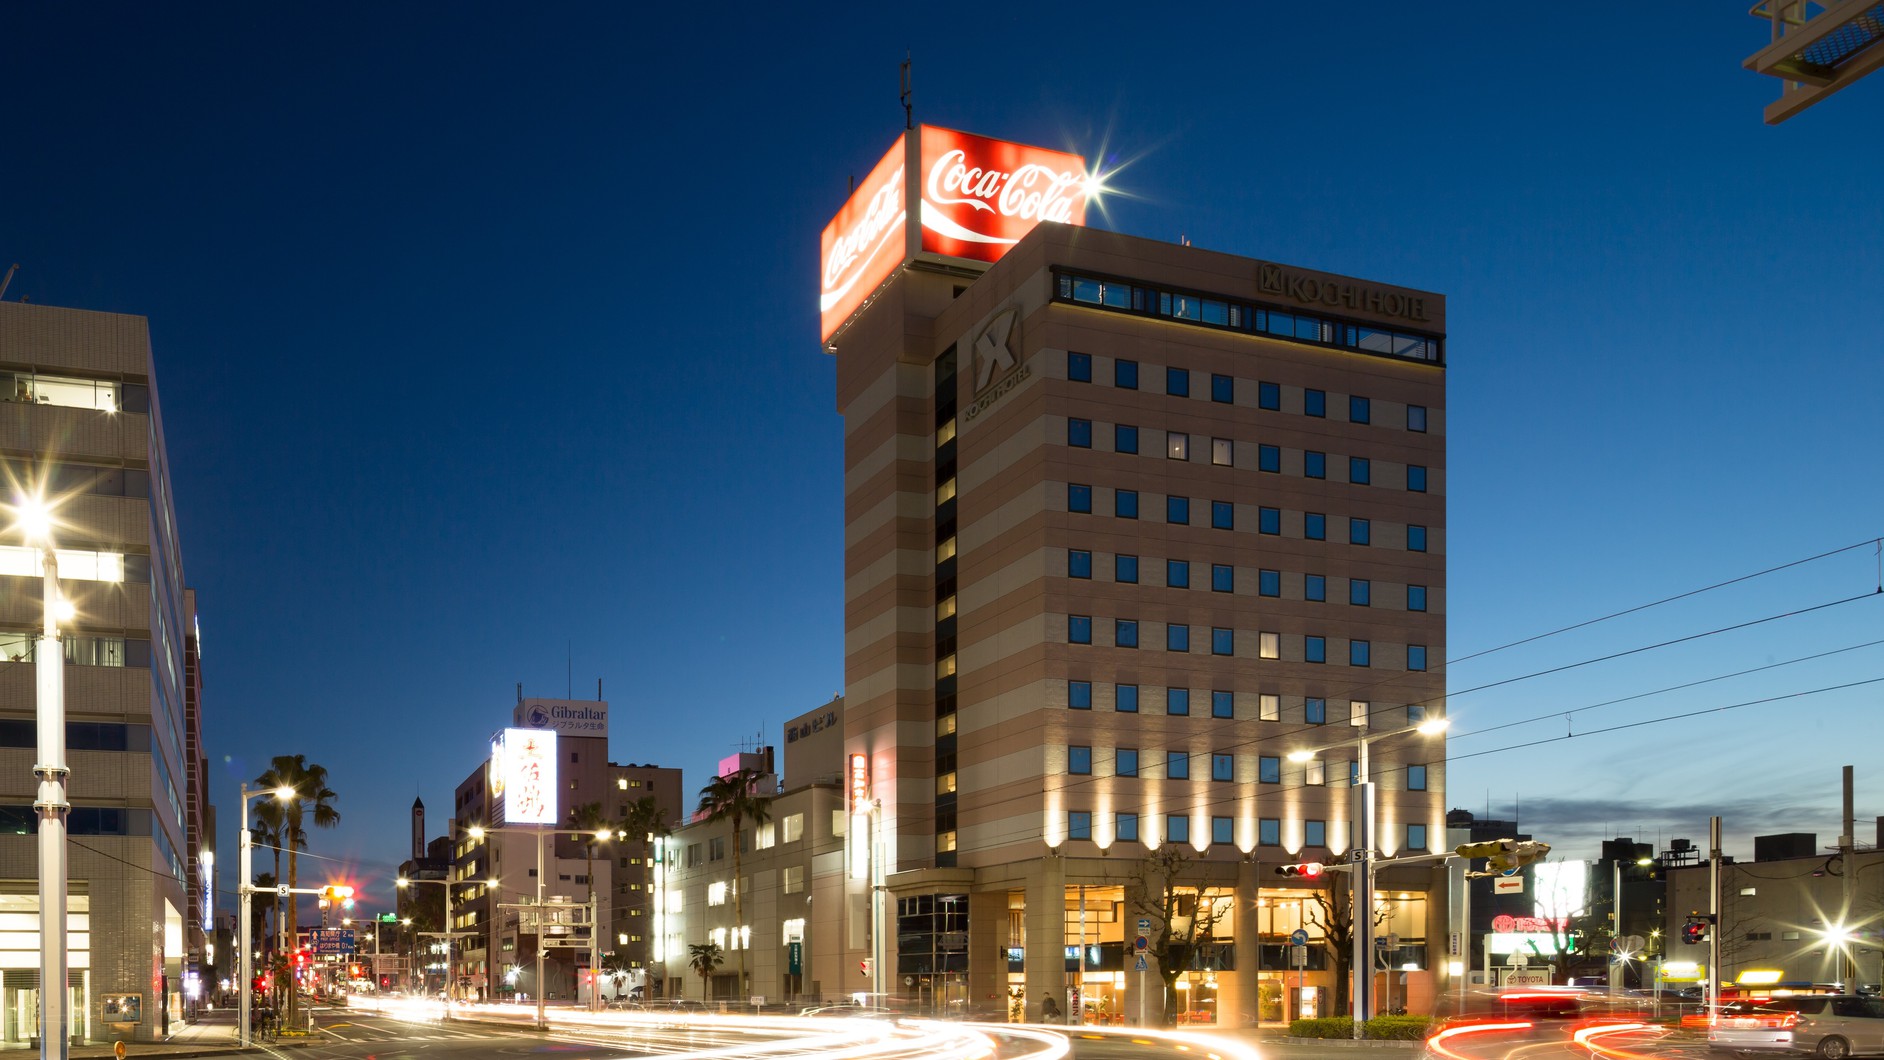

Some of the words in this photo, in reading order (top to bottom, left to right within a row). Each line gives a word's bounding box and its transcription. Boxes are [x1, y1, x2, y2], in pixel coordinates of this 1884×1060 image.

[928, 149, 1078, 224] Coca-Cola
[1287, 272, 1360, 309] KOCHI
[1363, 286, 1431, 321] HOTEL
[964, 391, 996, 422] KOCHI
[995, 366, 1031, 401] HOTEL
[551, 705, 606, 720] Gibraltar
[552, 721, 605, 731] ジブラルタ生命
[1517, 975, 1544, 983] TOYOTA
